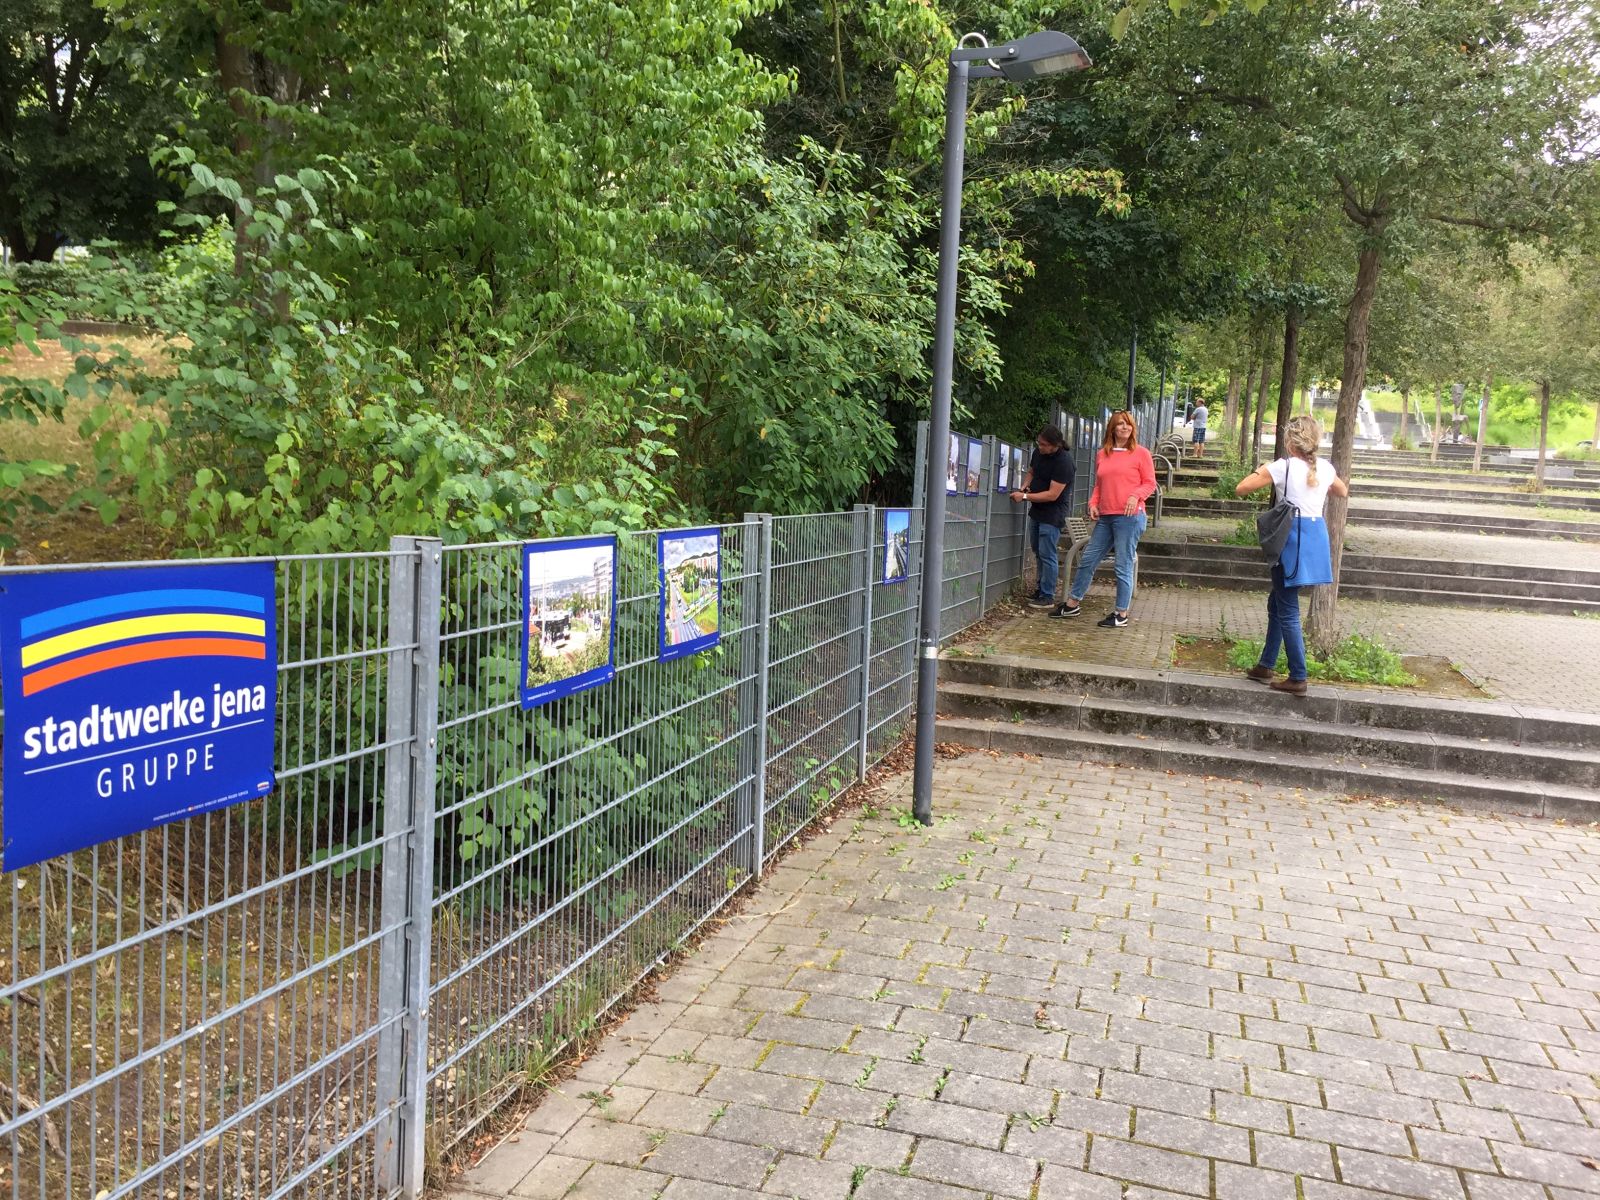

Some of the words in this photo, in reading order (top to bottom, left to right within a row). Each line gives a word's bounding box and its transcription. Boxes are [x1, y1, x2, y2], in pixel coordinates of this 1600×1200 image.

[23, 690, 205, 760] stadtwerke
[211, 682, 266, 729] jena
[96, 743, 215, 798] GRUPPE
